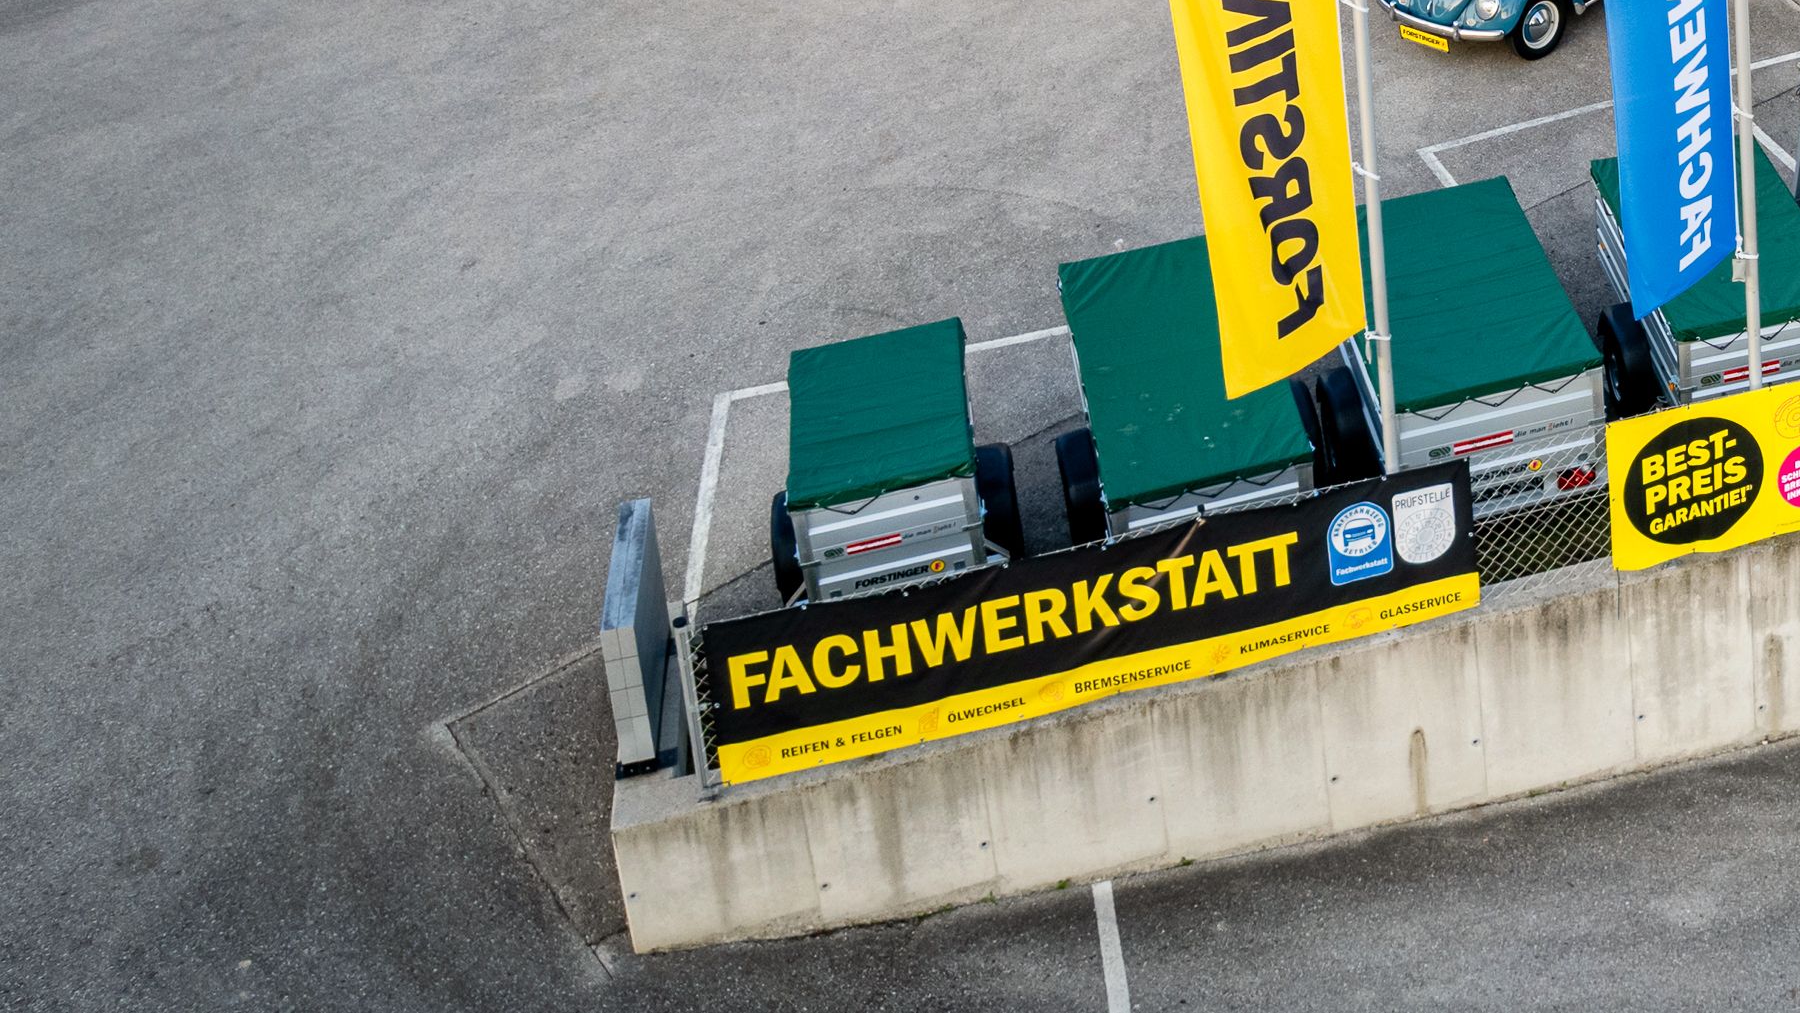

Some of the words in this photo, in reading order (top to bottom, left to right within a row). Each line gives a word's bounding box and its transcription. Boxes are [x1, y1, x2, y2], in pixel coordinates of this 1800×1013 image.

[1403, 29, 1440, 44] FORSTINGER
[1642, 429, 1737, 485] BEST-
[1395, 488, 1450, 511] PRÜFSTELLE
[1645, 456, 1747, 515] PREIS
[855, 565, 929, 589] FORSTINGER
[1336, 557, 1388, 576] Fachwerkstatt
[727, 531, 1298, 710] FACHWERKSTATT
[781, 740, 830, 759] REIFEN
[836, 736, 845, 748] &
[851, 725, 903, 745] FELGEN
[947, 697, 1027, 723] ÖLWECHSEL
[1074, 659, 1192, 693] BREMSENSERVICE
[1240, 624, 1331, 654] KLIMASERVICE
[1380, 592, 1462, 620] GLASSERVICE
